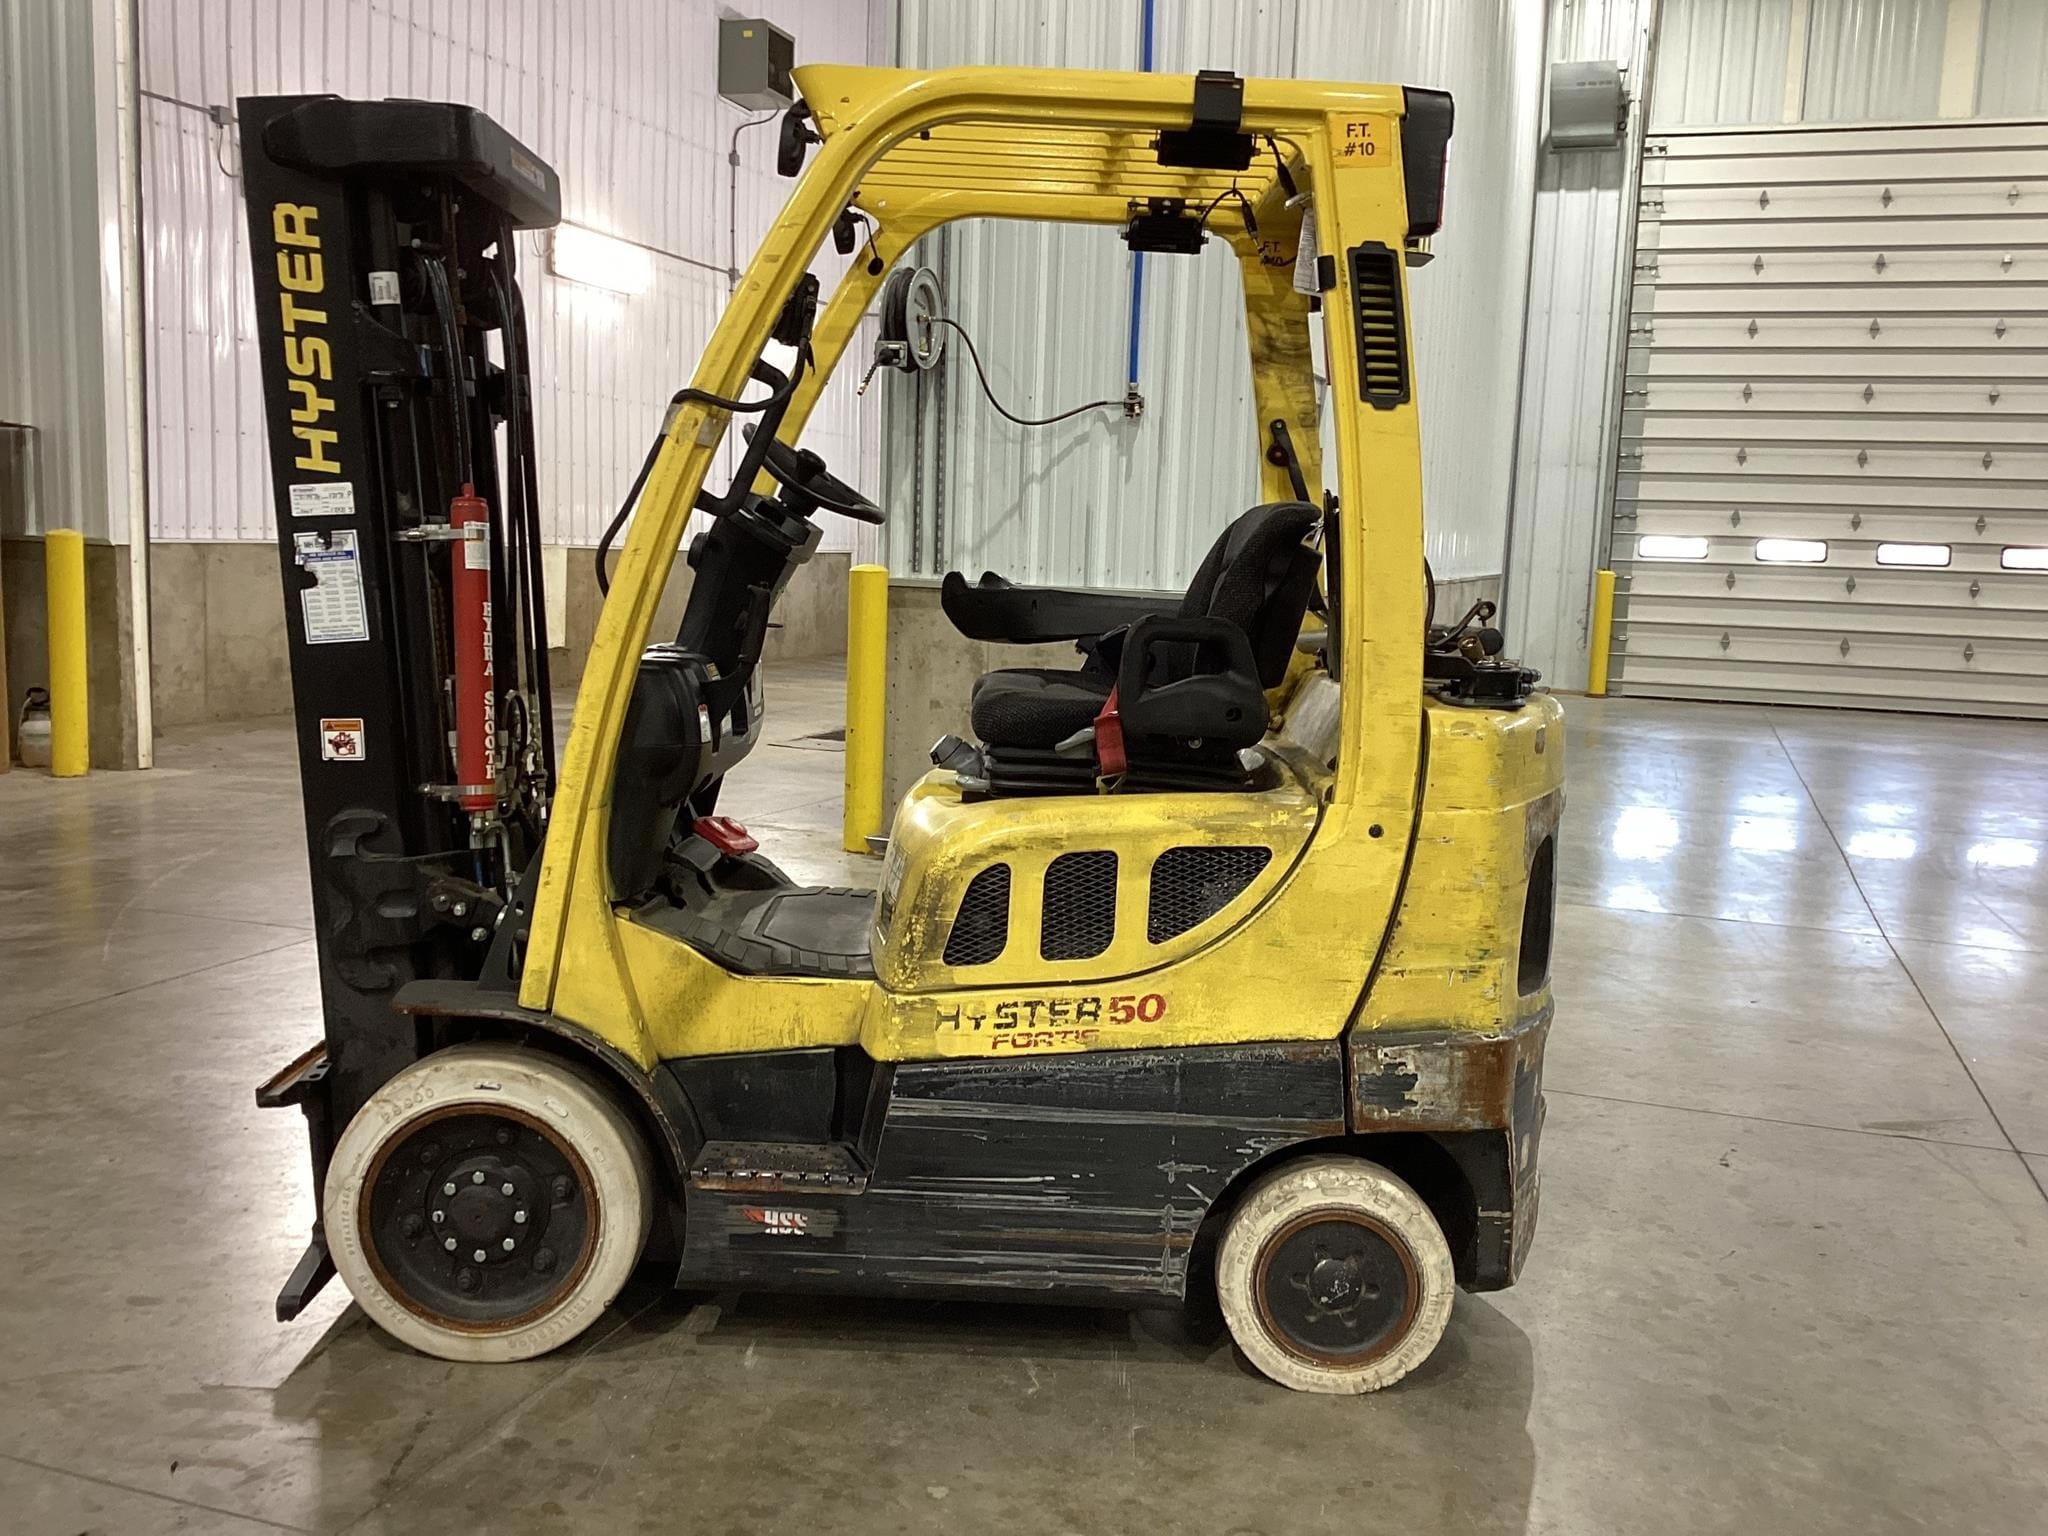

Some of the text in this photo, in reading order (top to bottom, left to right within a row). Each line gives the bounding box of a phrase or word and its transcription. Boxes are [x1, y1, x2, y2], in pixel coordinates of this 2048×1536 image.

[1346, 123, 1371, 138] F.T.
[1344, 142, 1375, 157] #10
[272, 202, 341, 474] HYSTER
[1108, 993, 1167, 1025] 50
